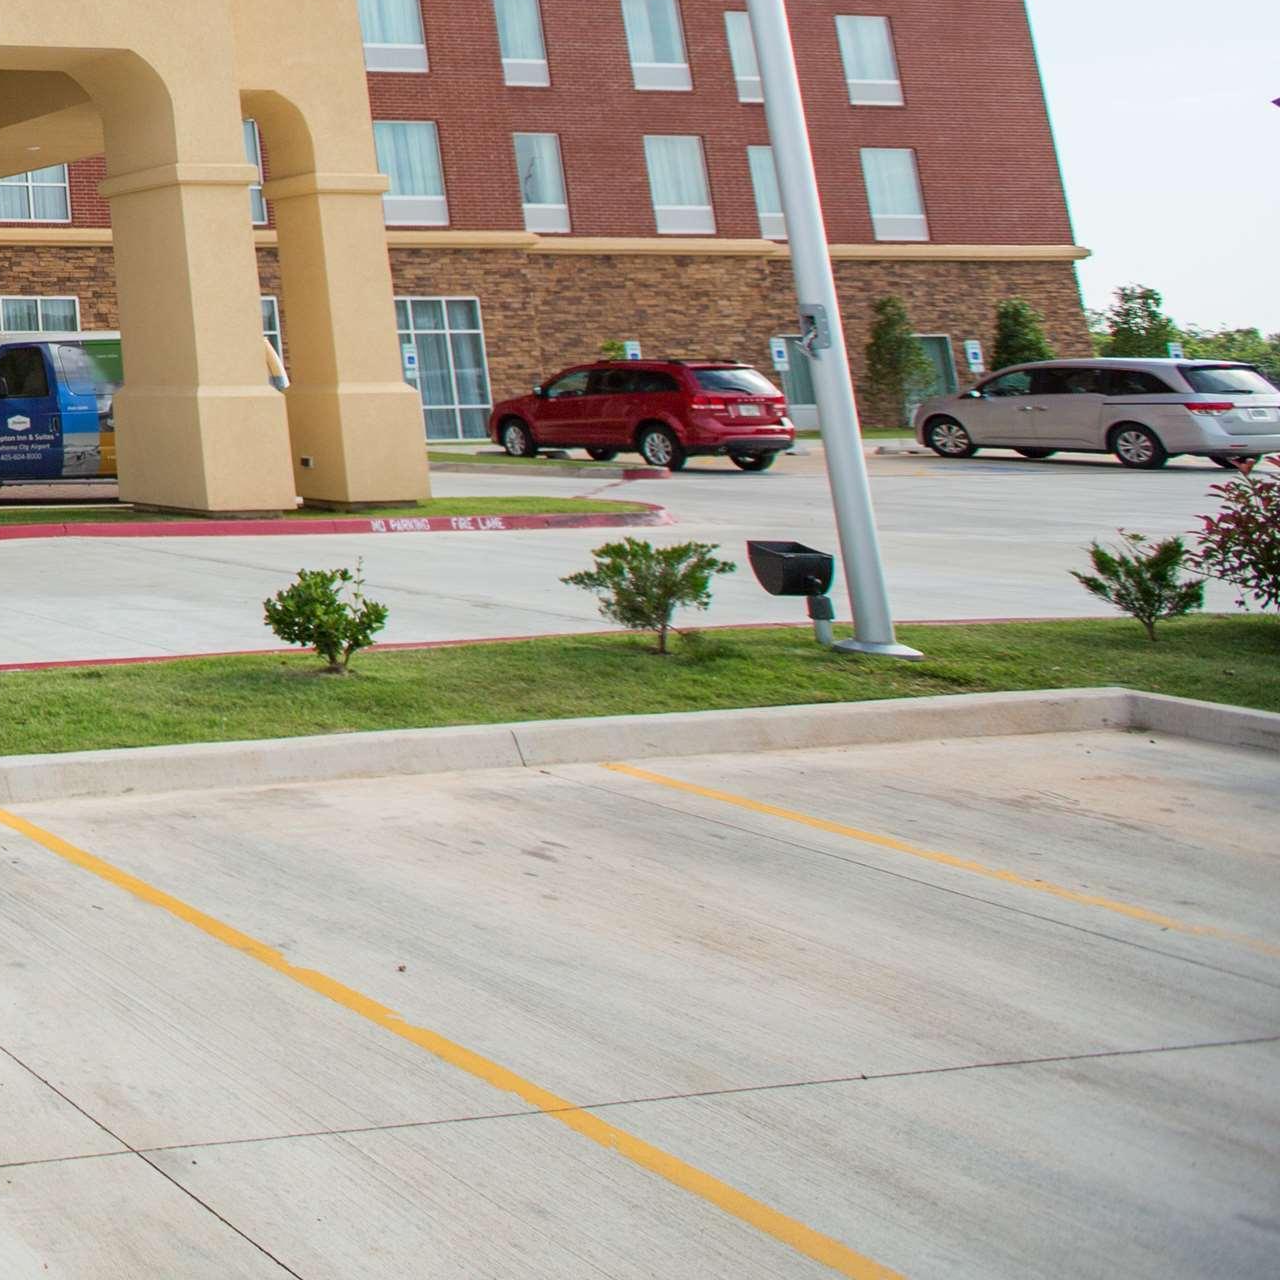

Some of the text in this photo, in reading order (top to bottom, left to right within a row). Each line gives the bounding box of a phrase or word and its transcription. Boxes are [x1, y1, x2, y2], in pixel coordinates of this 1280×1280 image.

[28, 433, 34, 441] &
[35, 433, 55, 441] Suites
[19, 443, 30, 452] City
[30, 443, 51, 451] Airport
[370, 516, 507, 532] NO PARKING FIRE LANE
